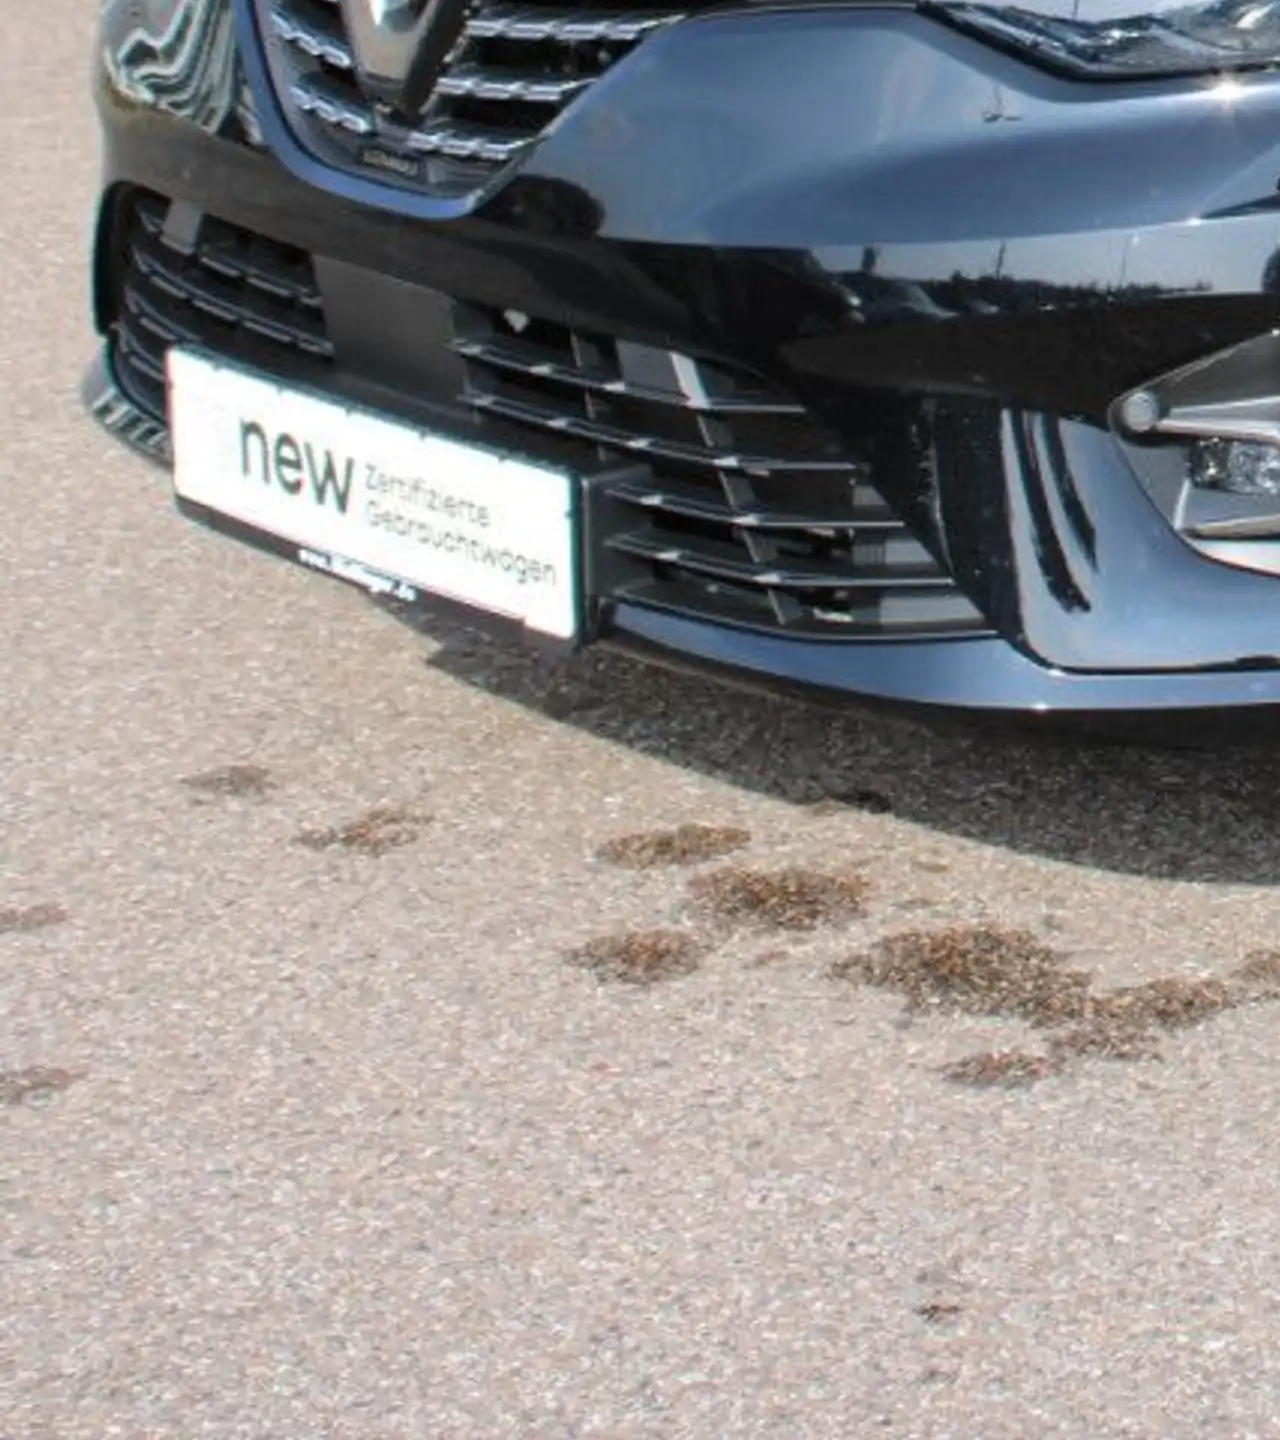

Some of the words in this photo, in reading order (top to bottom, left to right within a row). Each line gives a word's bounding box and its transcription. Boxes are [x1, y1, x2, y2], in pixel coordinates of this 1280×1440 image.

[240, 418, 354, 513] new
[364, 463, 492, 527] Zertifizierte
[366, 499, 557, 586] Gebrauchtwagen
